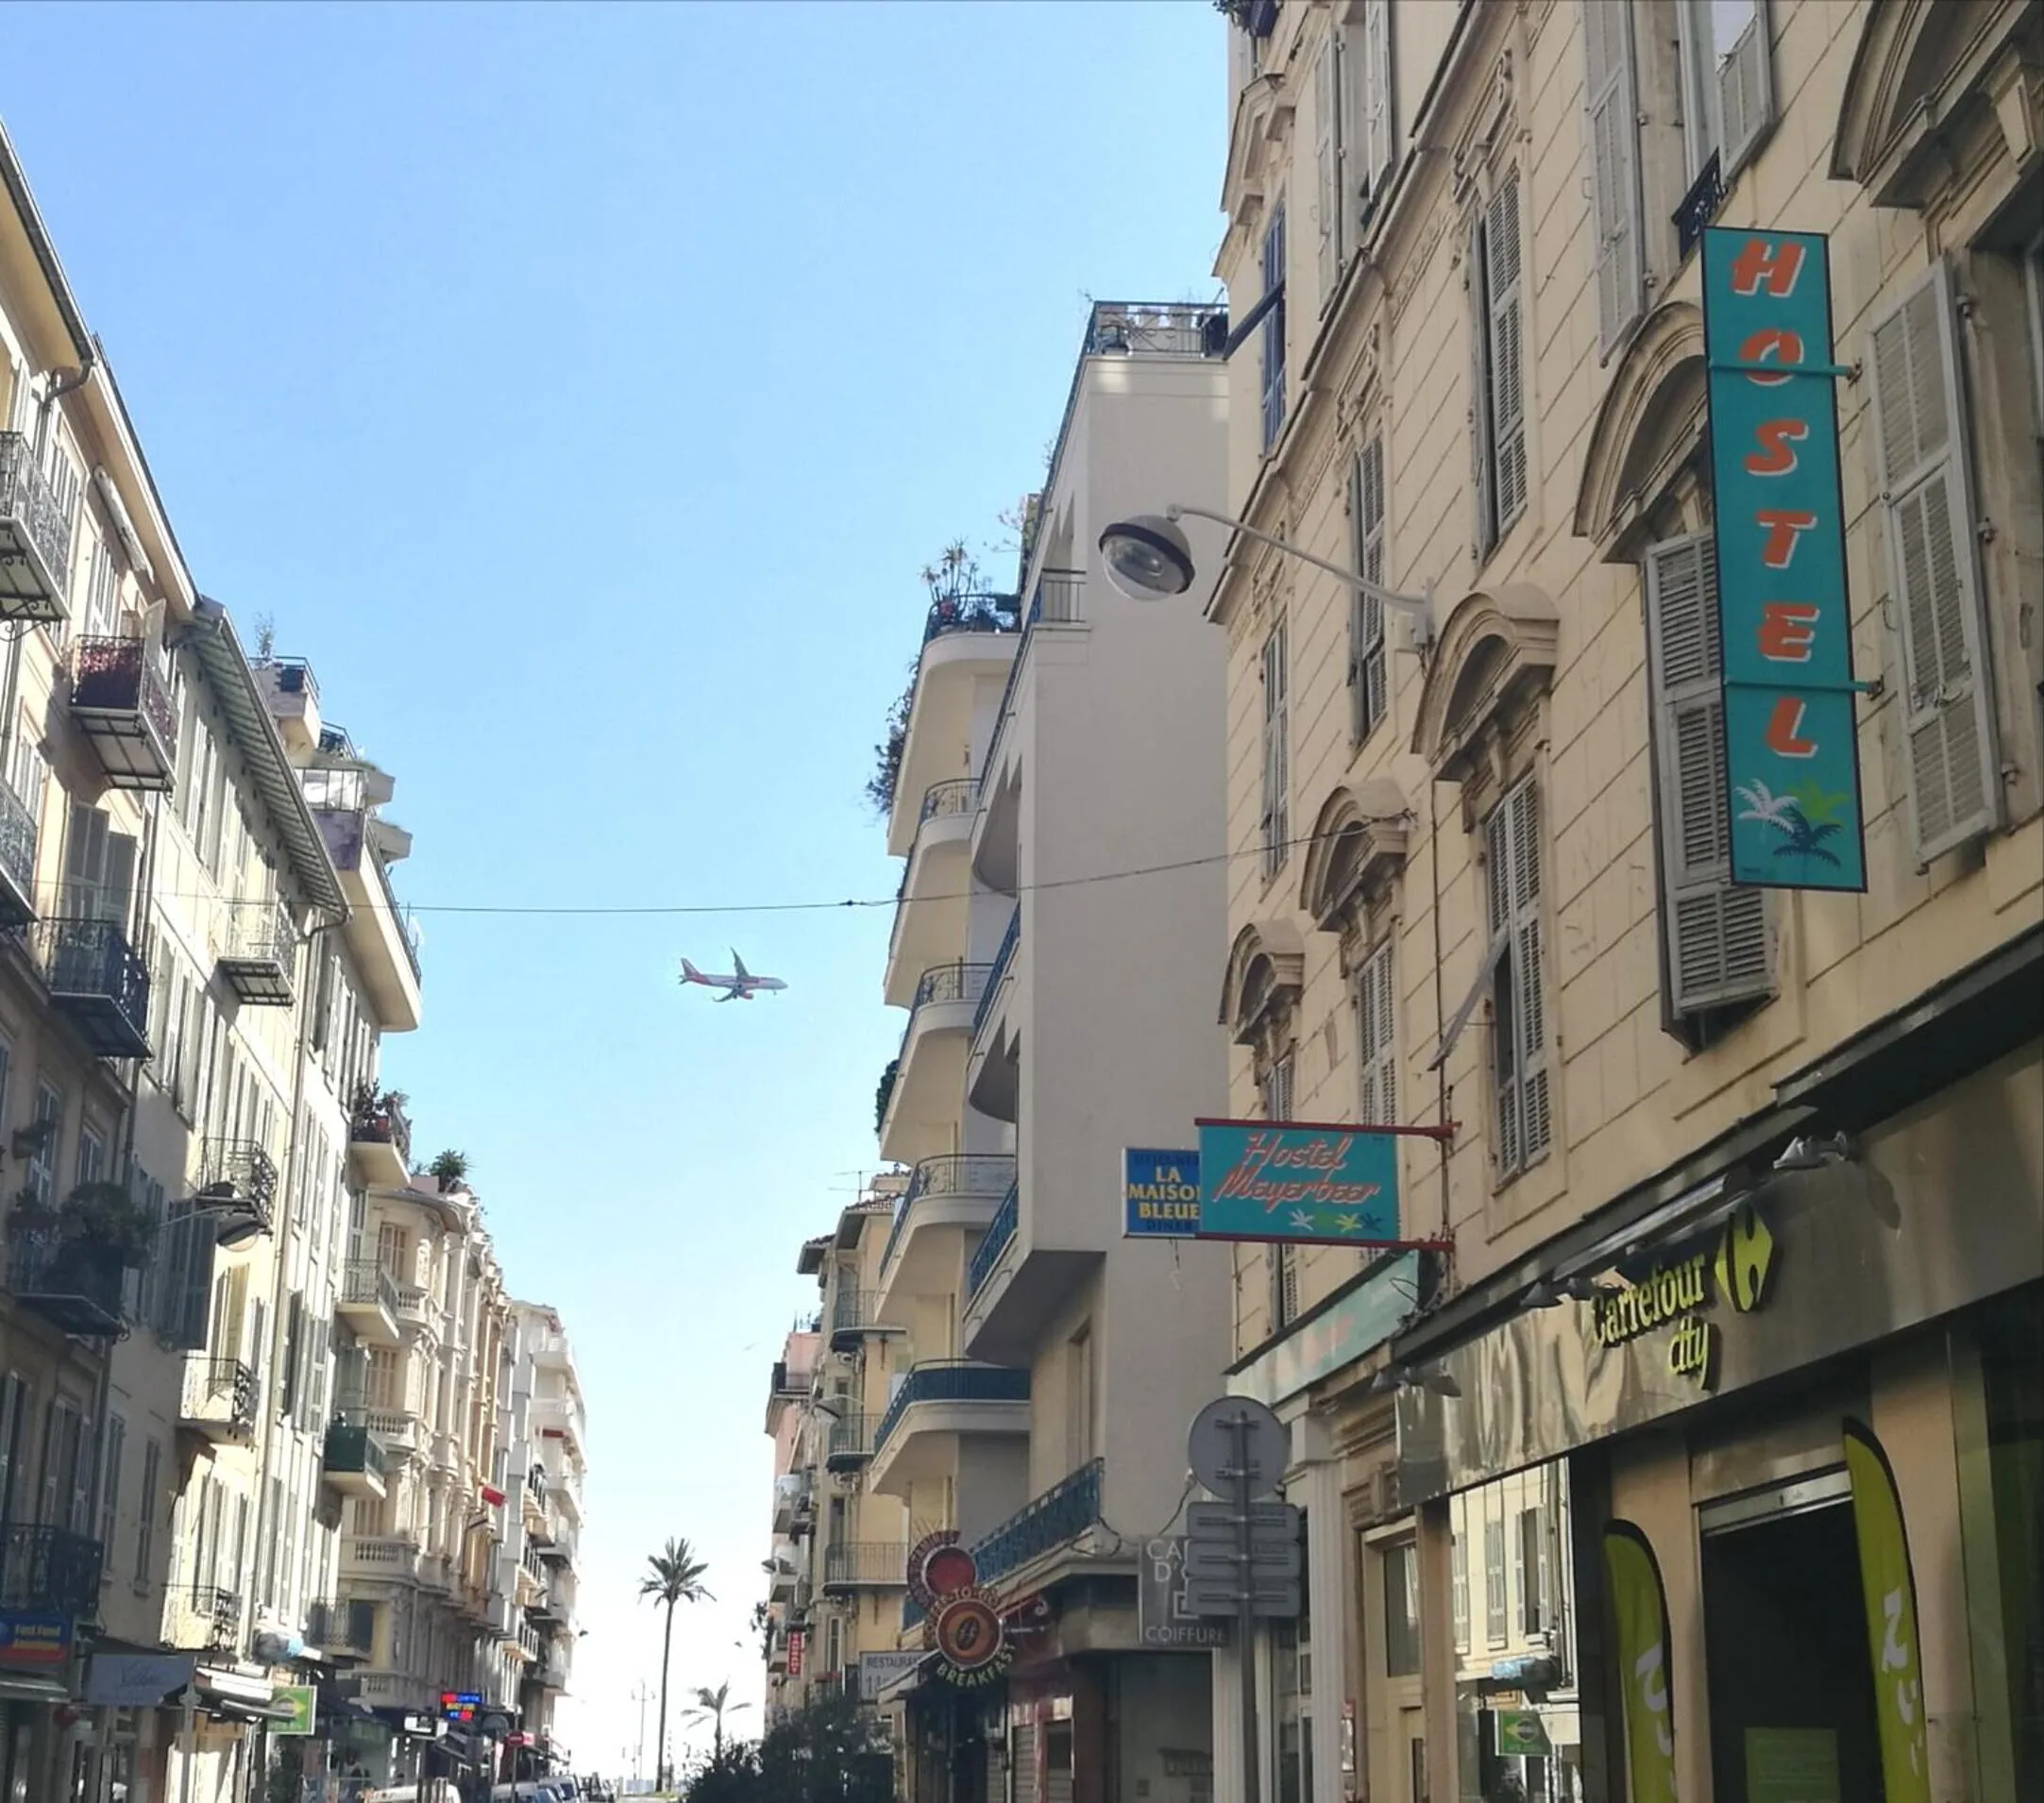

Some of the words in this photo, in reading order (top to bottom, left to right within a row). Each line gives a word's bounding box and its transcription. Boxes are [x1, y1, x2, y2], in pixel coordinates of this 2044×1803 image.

[1731, 238, 1820, 758] HOSTEL
[1241, 1133, 1354, 1171] Hostel
[1127, 1183, 1200, 1201] MAISO
[1155, 1166, 1182, 1183] LA
[1212, 1163, 1381, 1214] Meyerbeer
[1139, 1202, 1201, 1220] BLEUE
[1591, 1253, 1706, 1346] Carrefour
[1667, 1315, 1710, 1391] city
[1146, 1539, 1191, 1560] CA
[1145, 1625, 1225, 1644] COIFFURE
[936, 1642, 1016, 1688] BREAKFAST
